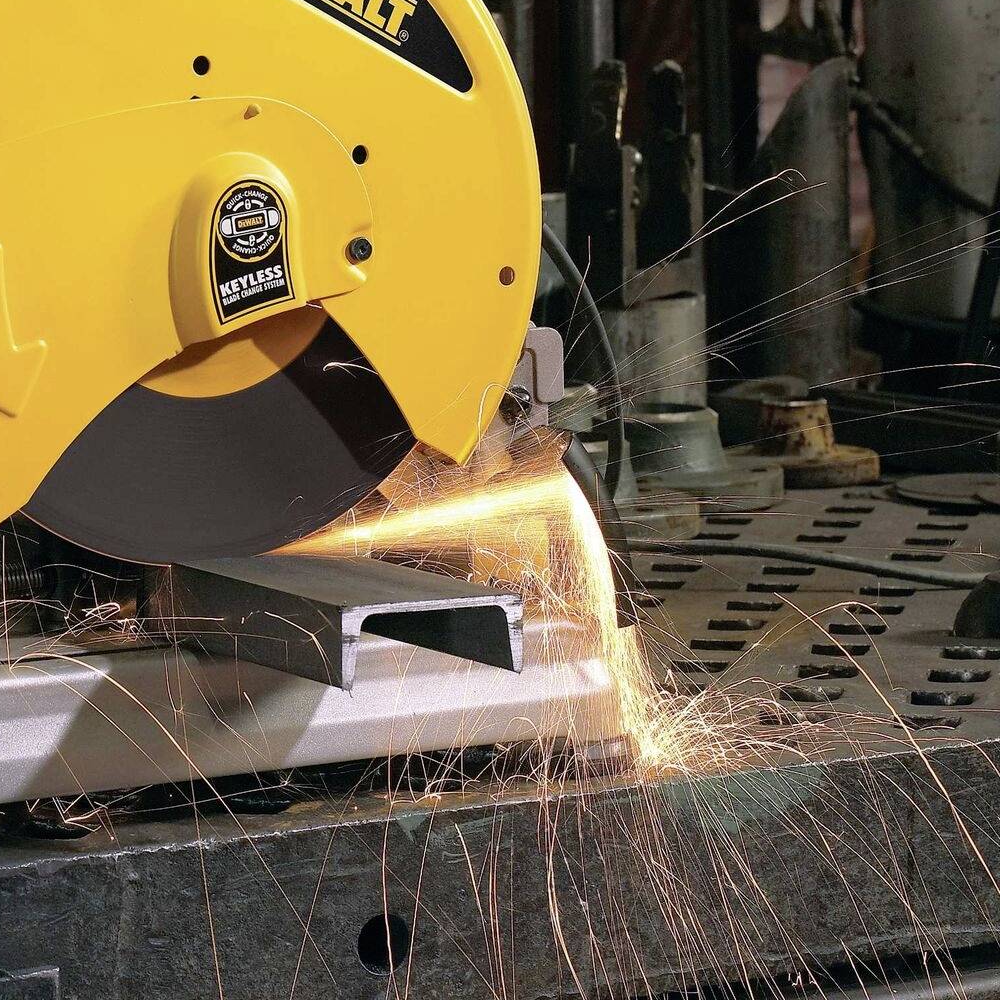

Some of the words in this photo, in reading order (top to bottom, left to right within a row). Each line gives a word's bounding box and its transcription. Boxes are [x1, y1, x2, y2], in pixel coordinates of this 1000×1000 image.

[226, 190, 269, 210] QUICK-CHANGE
[232, 234, 275, 255] QUICK-CHANGE
[219, 264, 283, 298] KEYLESS
[222, 292, 241, 306] BLADE
[240, 284, 263, 299] CHANGE
[263, 278, 286, 292] SYSTEM
